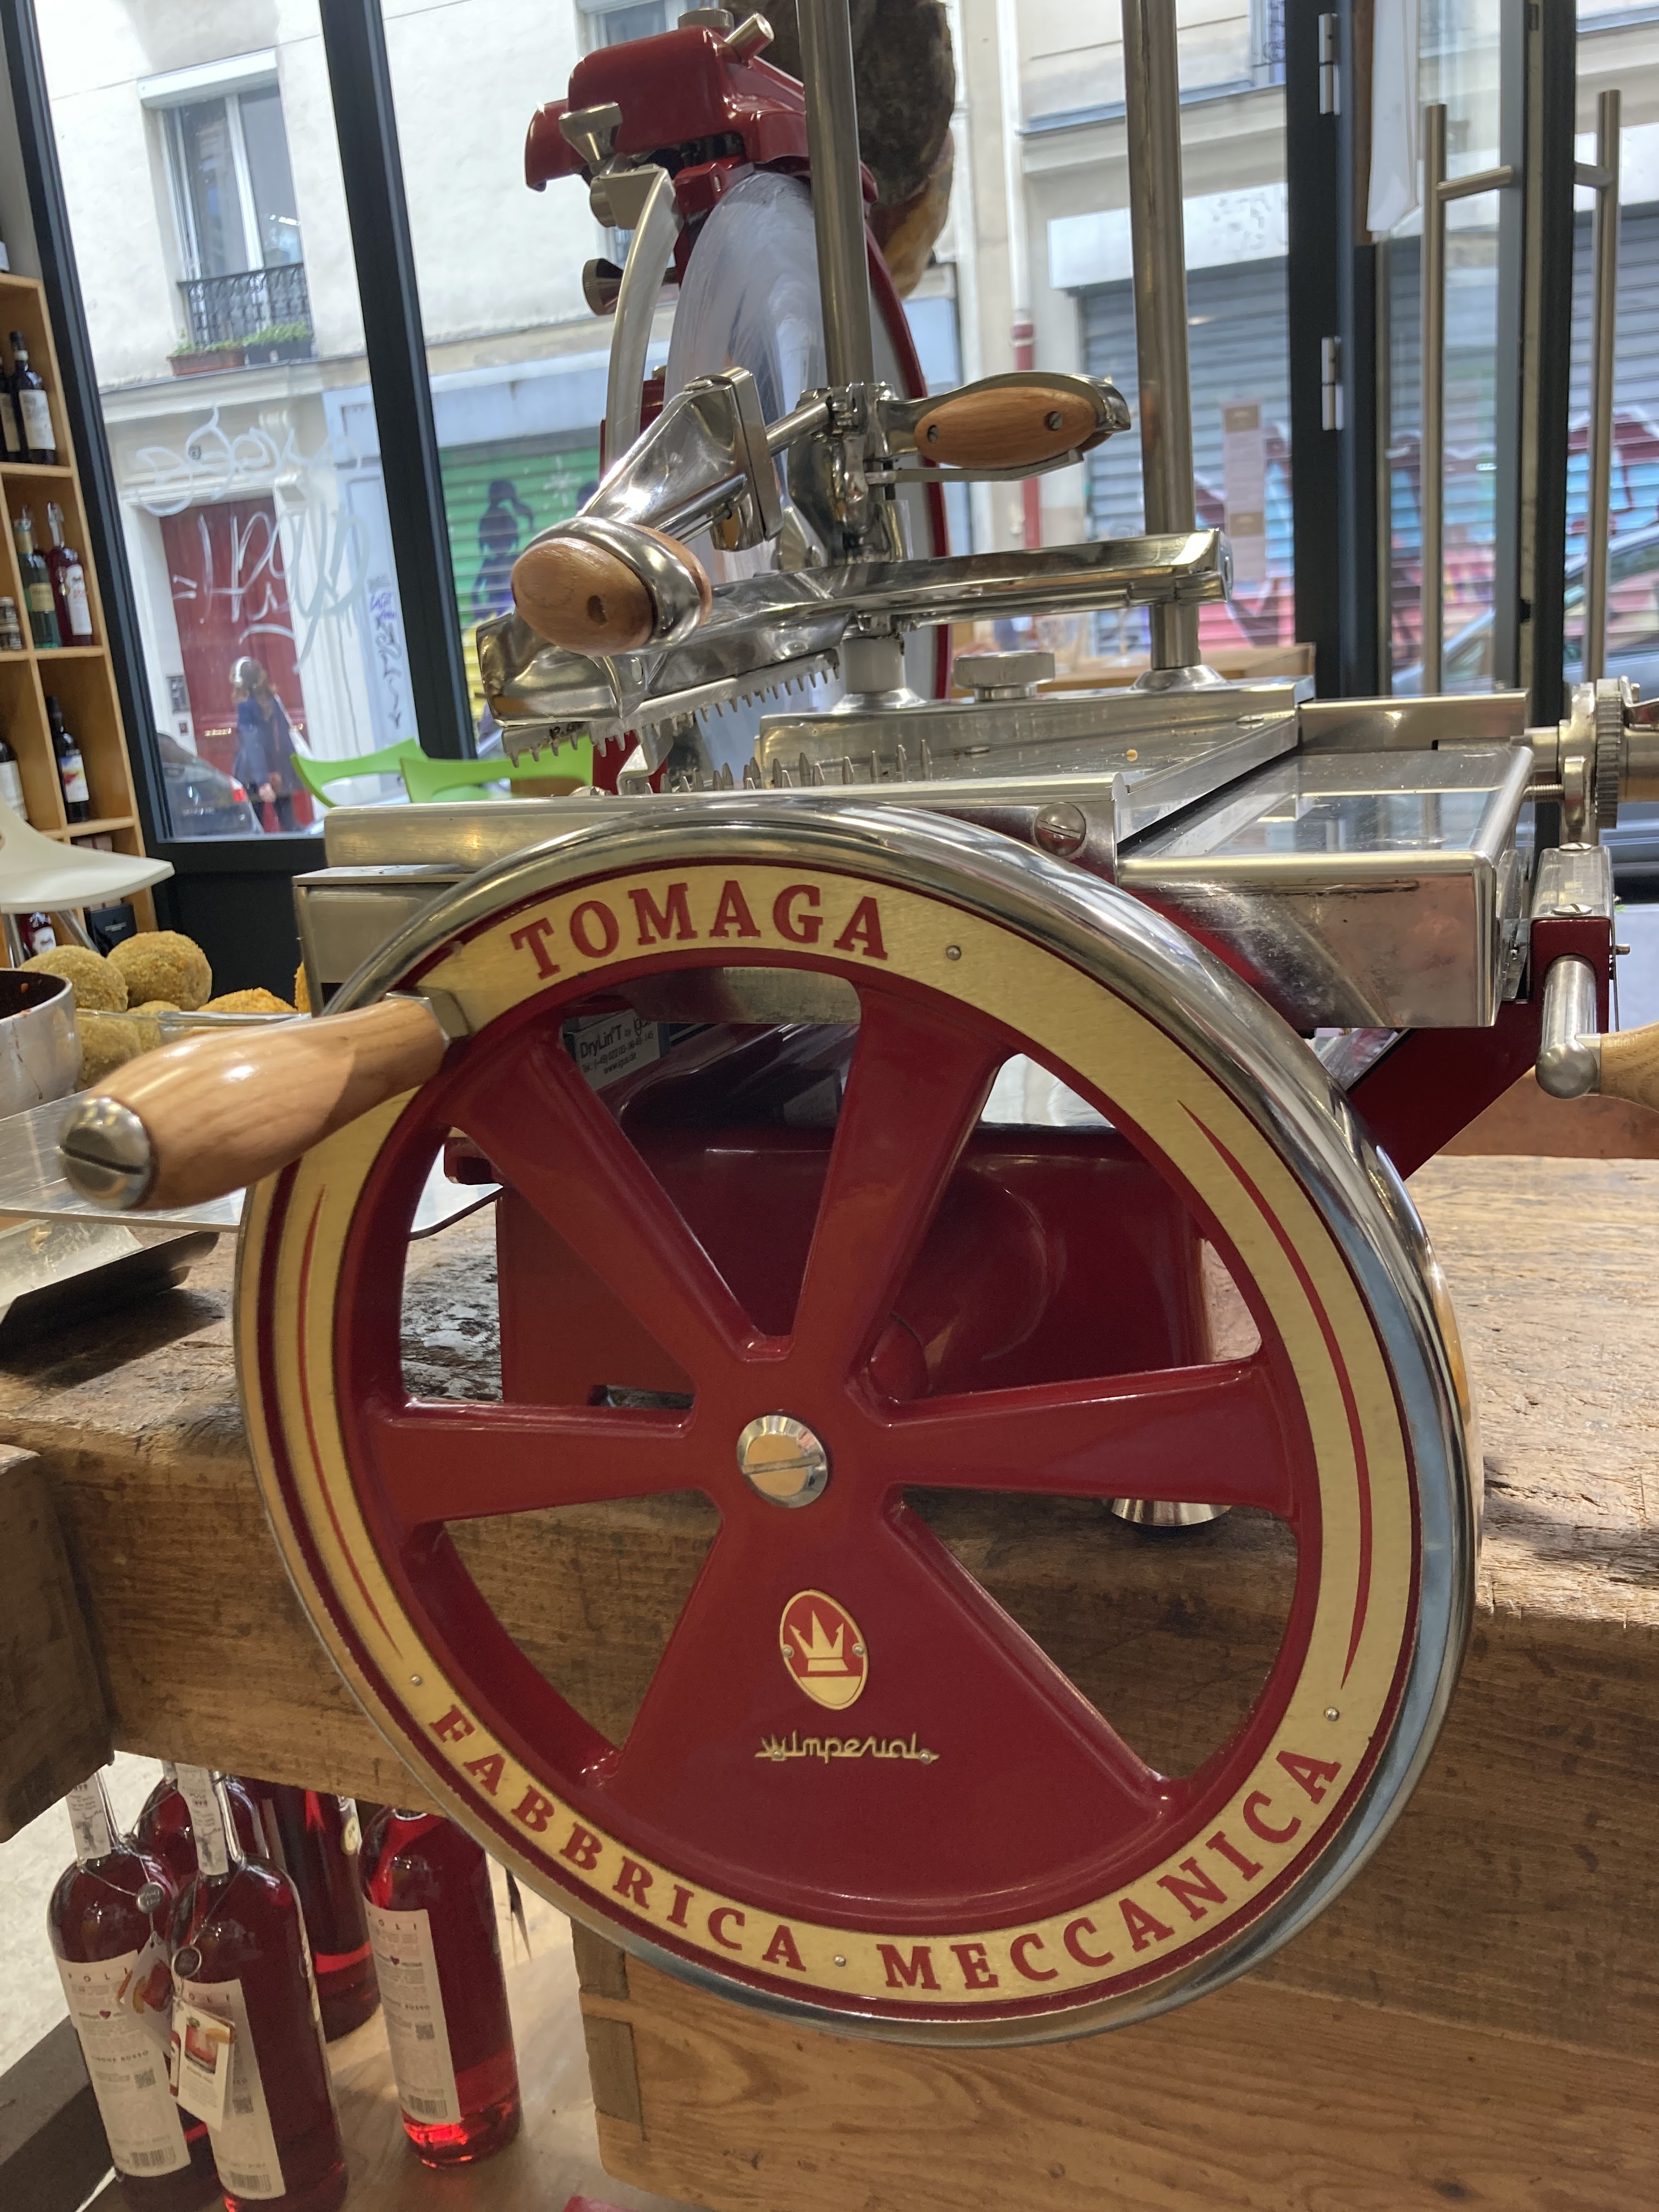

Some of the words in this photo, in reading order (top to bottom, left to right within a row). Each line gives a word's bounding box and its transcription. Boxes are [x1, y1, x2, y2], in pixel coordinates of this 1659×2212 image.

[510, 880, 888, 980] TOMAGA
[782, 1729, 930, 1764] Imperial
[429, 1705, 806, 1972] FABBRICA
[876, 1750, 1341, 1990] MECCANICA
